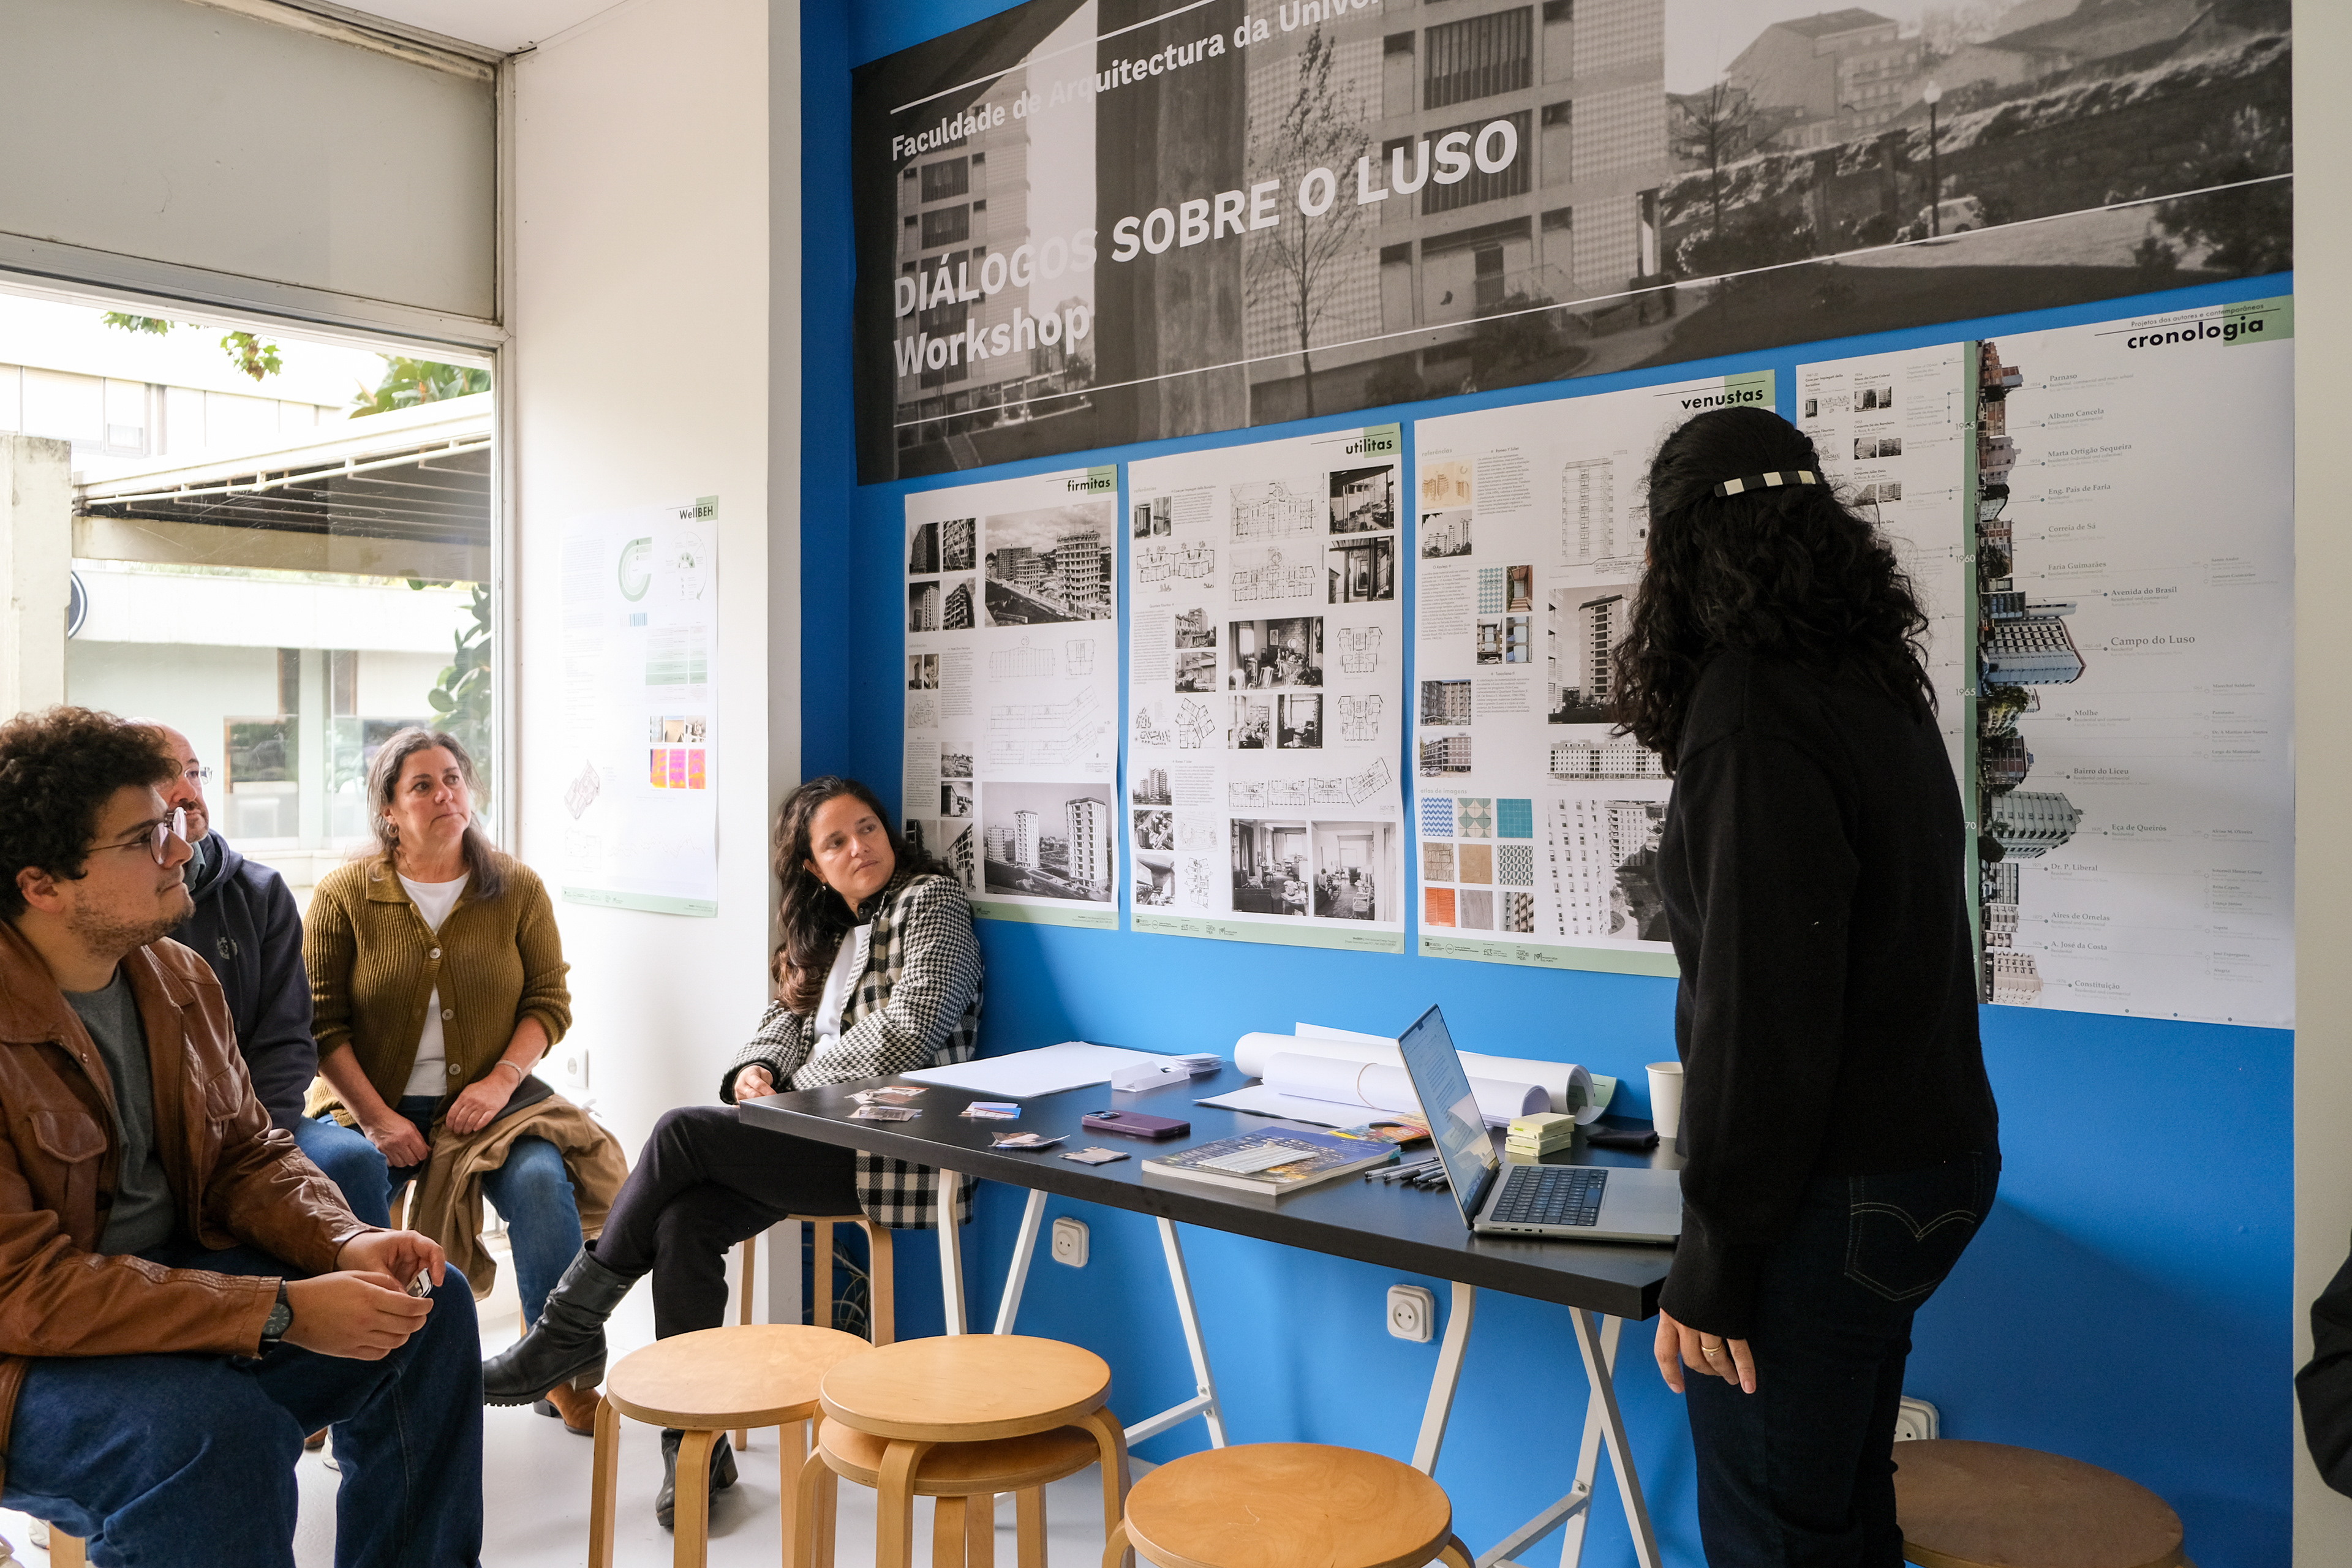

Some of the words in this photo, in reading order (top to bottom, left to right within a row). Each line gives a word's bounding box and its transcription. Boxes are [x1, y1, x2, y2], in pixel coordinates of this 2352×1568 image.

[892, 103, 1005, 161] Faculdade
[1012, 91, 1041, 121] de
[1049, 34, 1225, 108] Arquitectura
[1234, 15, 1270, 48] da
[1280, 0, 1378, 32] Univ
[894, 228, 1098, 318] DIÁLOGOS
[1112, 179, 1280, 262] SOBRE
[1298, 167, 1336, 217] O
[1357, 119, 1518, 205] LUSO
[2131, 318, 2157, 328] Projetos
[2206, 304, 2264, 317] contemporâneos
[2127, 315, 2264, 349] cronologia
[894, 305, 1090, 378] Workshop
[1681, 390, 1763, 410] venustas
[2048, 411, 2074, 420] Albano
[2076, 408, 2105, 417] Cancela
[1346, 439, 1392, 454] utilitas
[1422, 448, 1452, 456] referências
[2070, 447, 2098, 456] Ortigão
[2100, 443, 2132, 453] Sequeira
[1067, 477, 1110, 492] firmitas
[679, 505, 714, 519] WellBEH
[1955, 554, 1975, 563] 1960
[2067, 561, 2107, 570] Guimarães
[2111, 636, 2149, 647] Campo
[2152, 635, 2166, 644] do
[2169, 635, 2195, 644] Luso
[2082, 913, 2110, 921] Ornelas
[2075, 979, 2120, 990] Constituição
